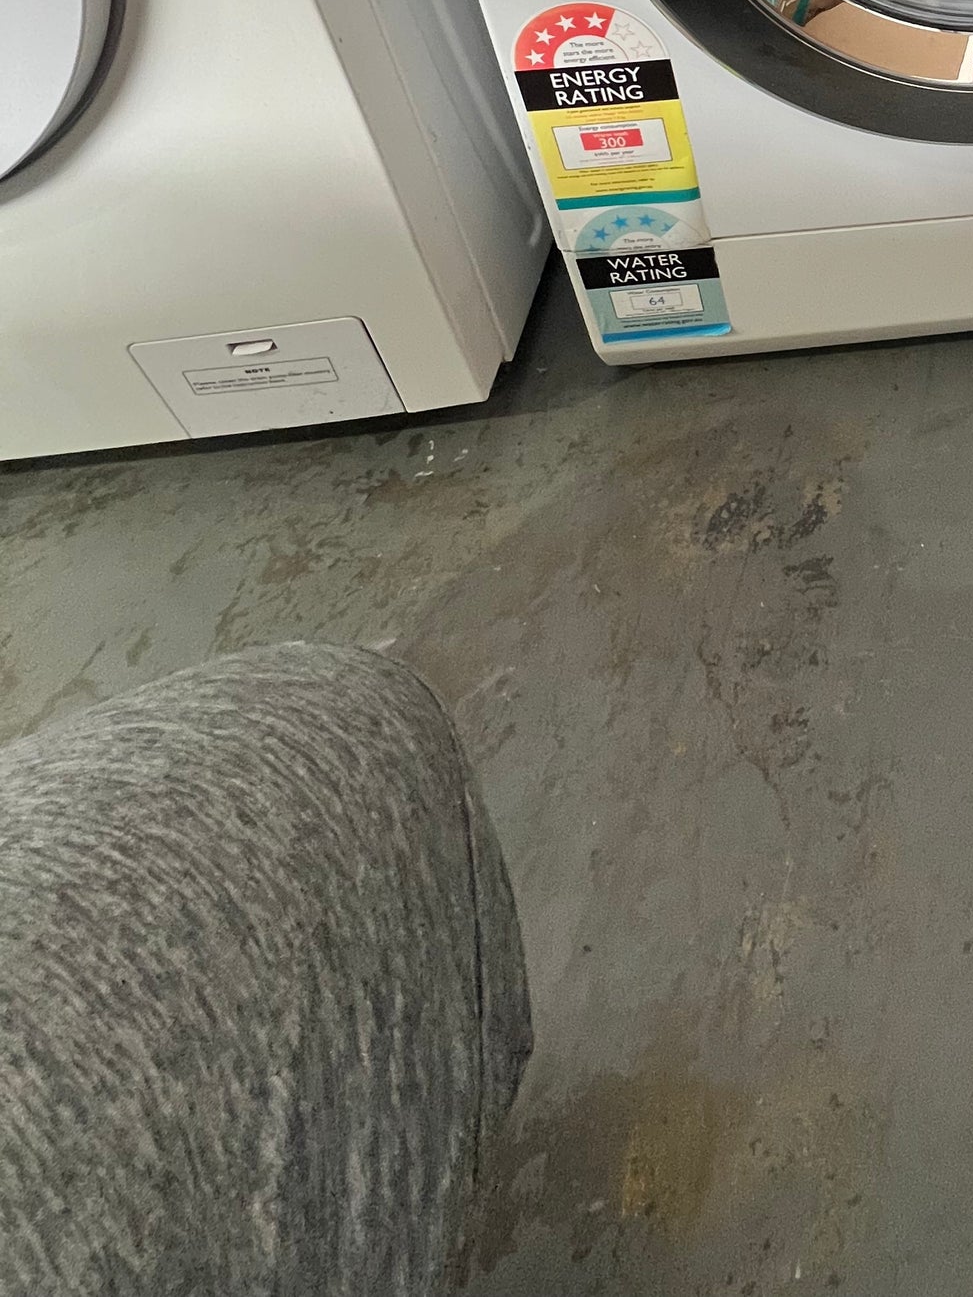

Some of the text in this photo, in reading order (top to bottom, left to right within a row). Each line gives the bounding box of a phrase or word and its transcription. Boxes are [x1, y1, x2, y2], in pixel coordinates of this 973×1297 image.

[549, 66, 641, 89] ENERGY
[555, 84, 645, 106] RATING
[599, 136, 627, 150] 300
[607, 253, 683, 270] WATER
[610, 266, 688, 284] RATING
[648, 296, 666, 306] 64
